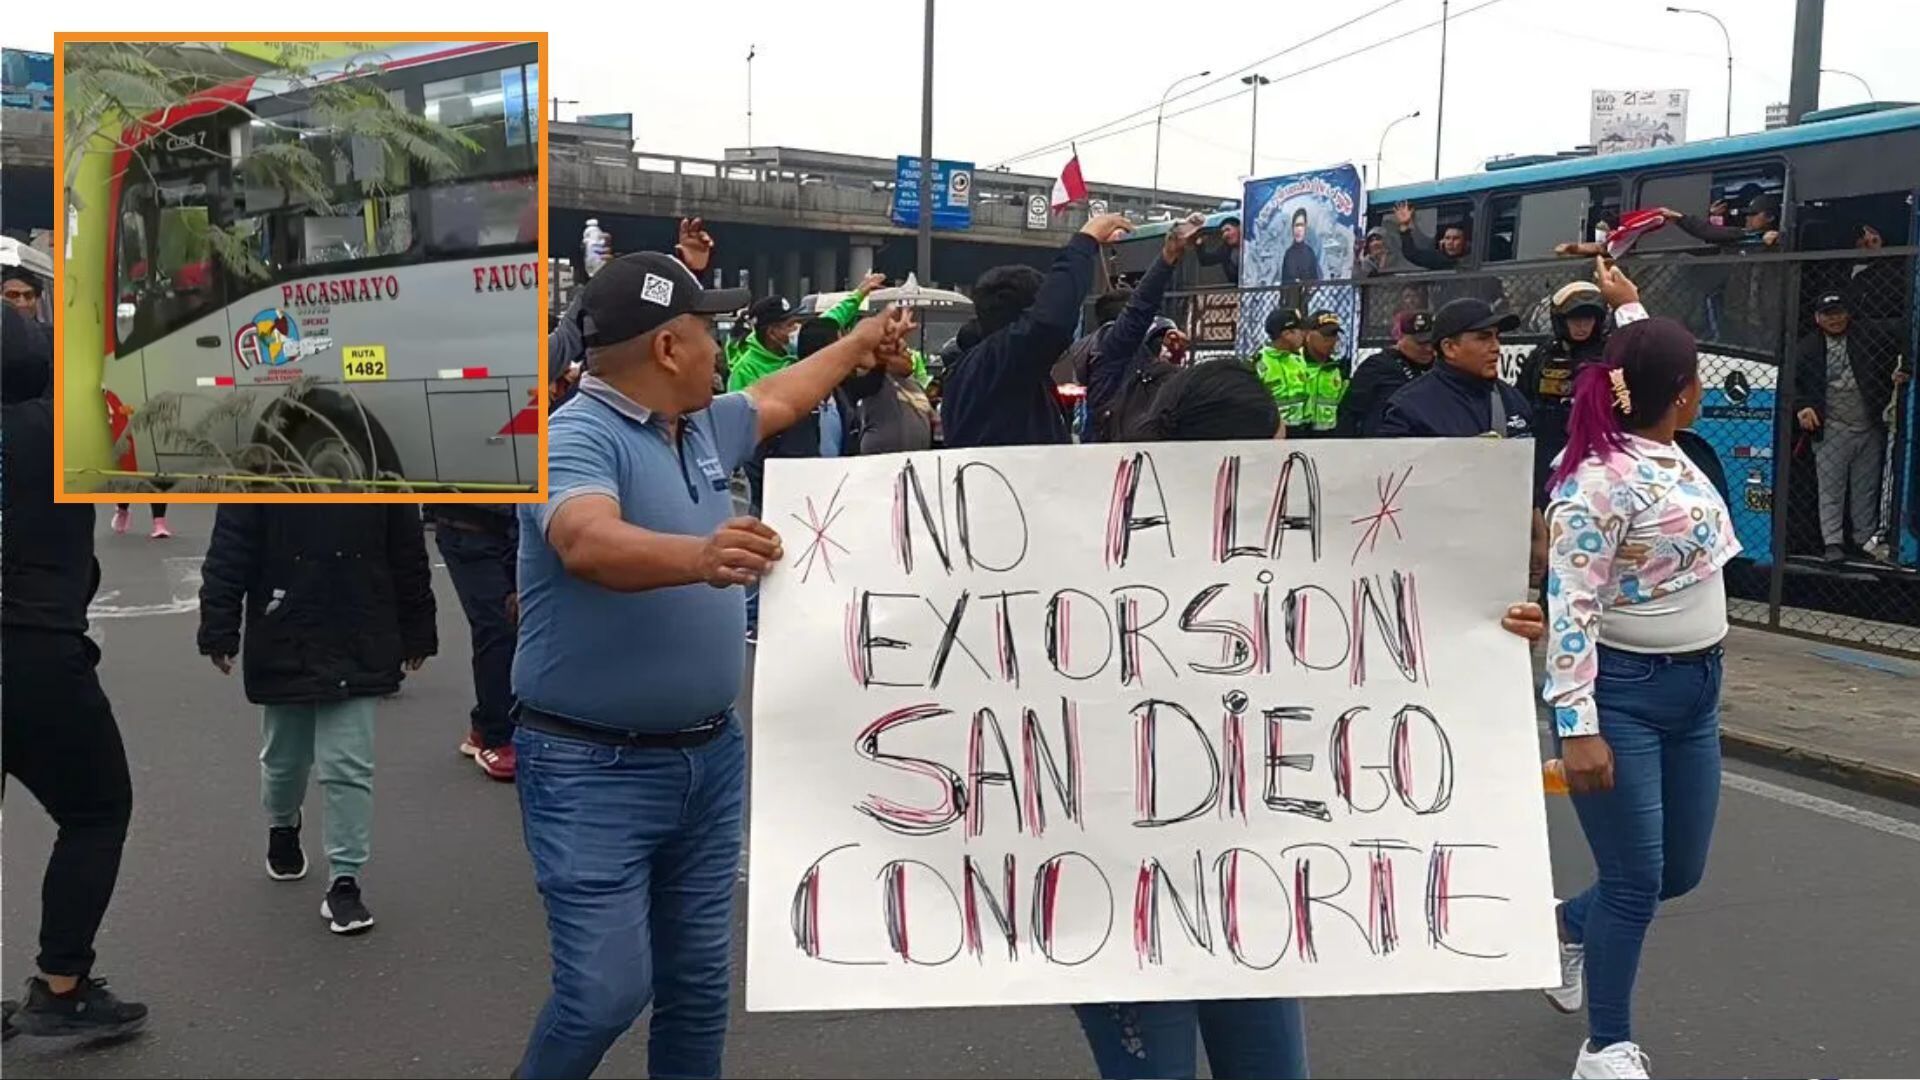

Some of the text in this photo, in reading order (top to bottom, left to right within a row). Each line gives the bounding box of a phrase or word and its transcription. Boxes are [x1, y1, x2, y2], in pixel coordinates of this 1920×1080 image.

[282, 275, 399, 308] PACASMAYO
[346, 362, 385, 376] 1482
[351, 350, 376, 358] RUTA
[892, 451, 1321, 574] NO A LA
[854, 697, 1084, 840] SAN
[791, 838, 1509, 970] CONO NORTE
